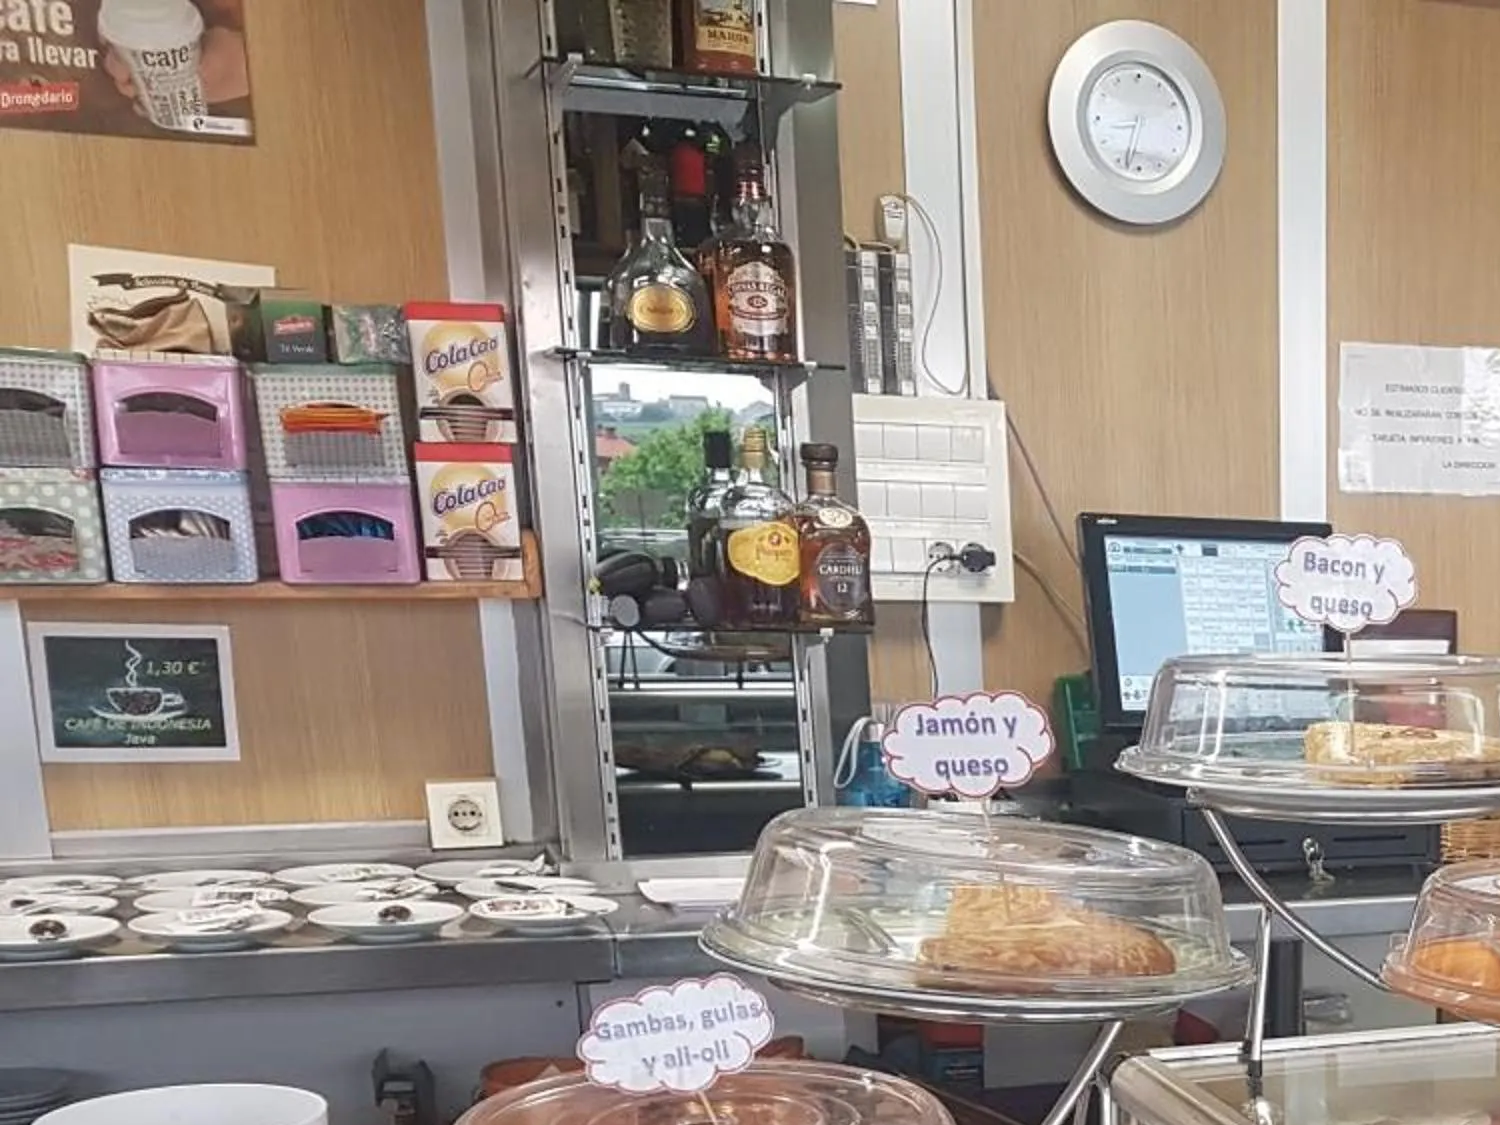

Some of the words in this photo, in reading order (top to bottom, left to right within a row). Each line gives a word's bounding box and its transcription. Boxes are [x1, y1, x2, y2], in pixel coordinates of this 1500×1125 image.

[28, 37, 98, 69] llevar
[425, 336, 498, 374] ColaCao
[433, 475, 507, 515] ColaCao
[1303, 551, 1367, 578] Bacon
[1373, 562, 1385, 584] y
[1310, 595, 1373, 616] queso
[145, 661, 182, 677] 1,30
[130, 718, 212, 731] INDONESIA
[915, 711, 996, 737] Jamón
[1003, 715, 1017, 738] y
[124, 733, 157, 746] Java
[935, 757, 1009, 780] queso
[596, 1012, 694, 1041] Gambas,
[699, 1000, 762, 1029] gulas
[663, 1039, 731, 1069] ali-oli
